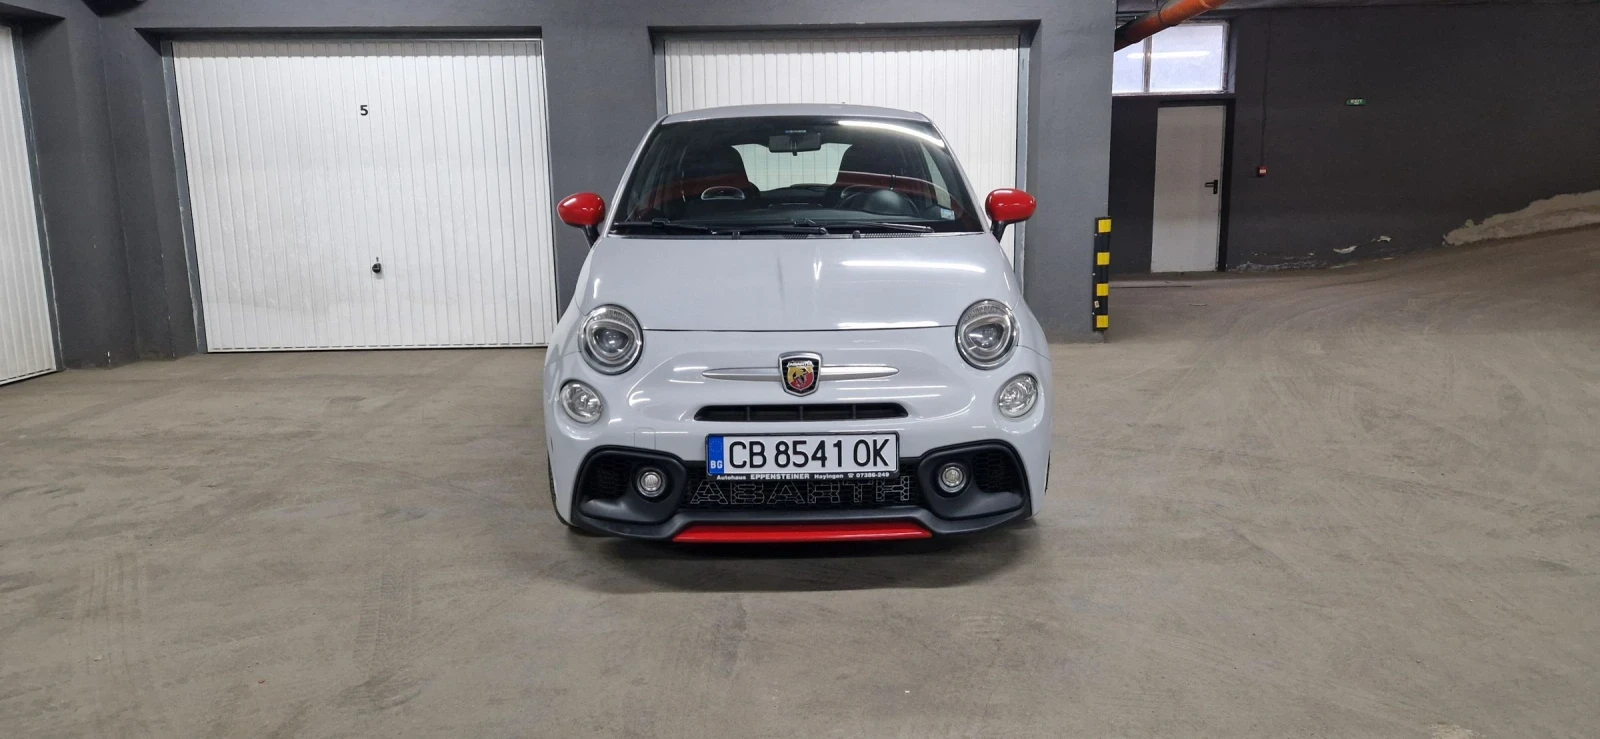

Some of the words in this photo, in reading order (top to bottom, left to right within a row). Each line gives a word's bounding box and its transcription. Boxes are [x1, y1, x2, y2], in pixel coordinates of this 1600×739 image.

[360, 104, 369, 116] 5
[729, 440, 767, 469] CB
[774, 440, 842, 468] 8541
[853, 439, 890, 467] OK
[710, 460, 723, 469] BG
[855, 471, 890, 479] 07386-249
[690, 476, 910, 505] ABARTH
